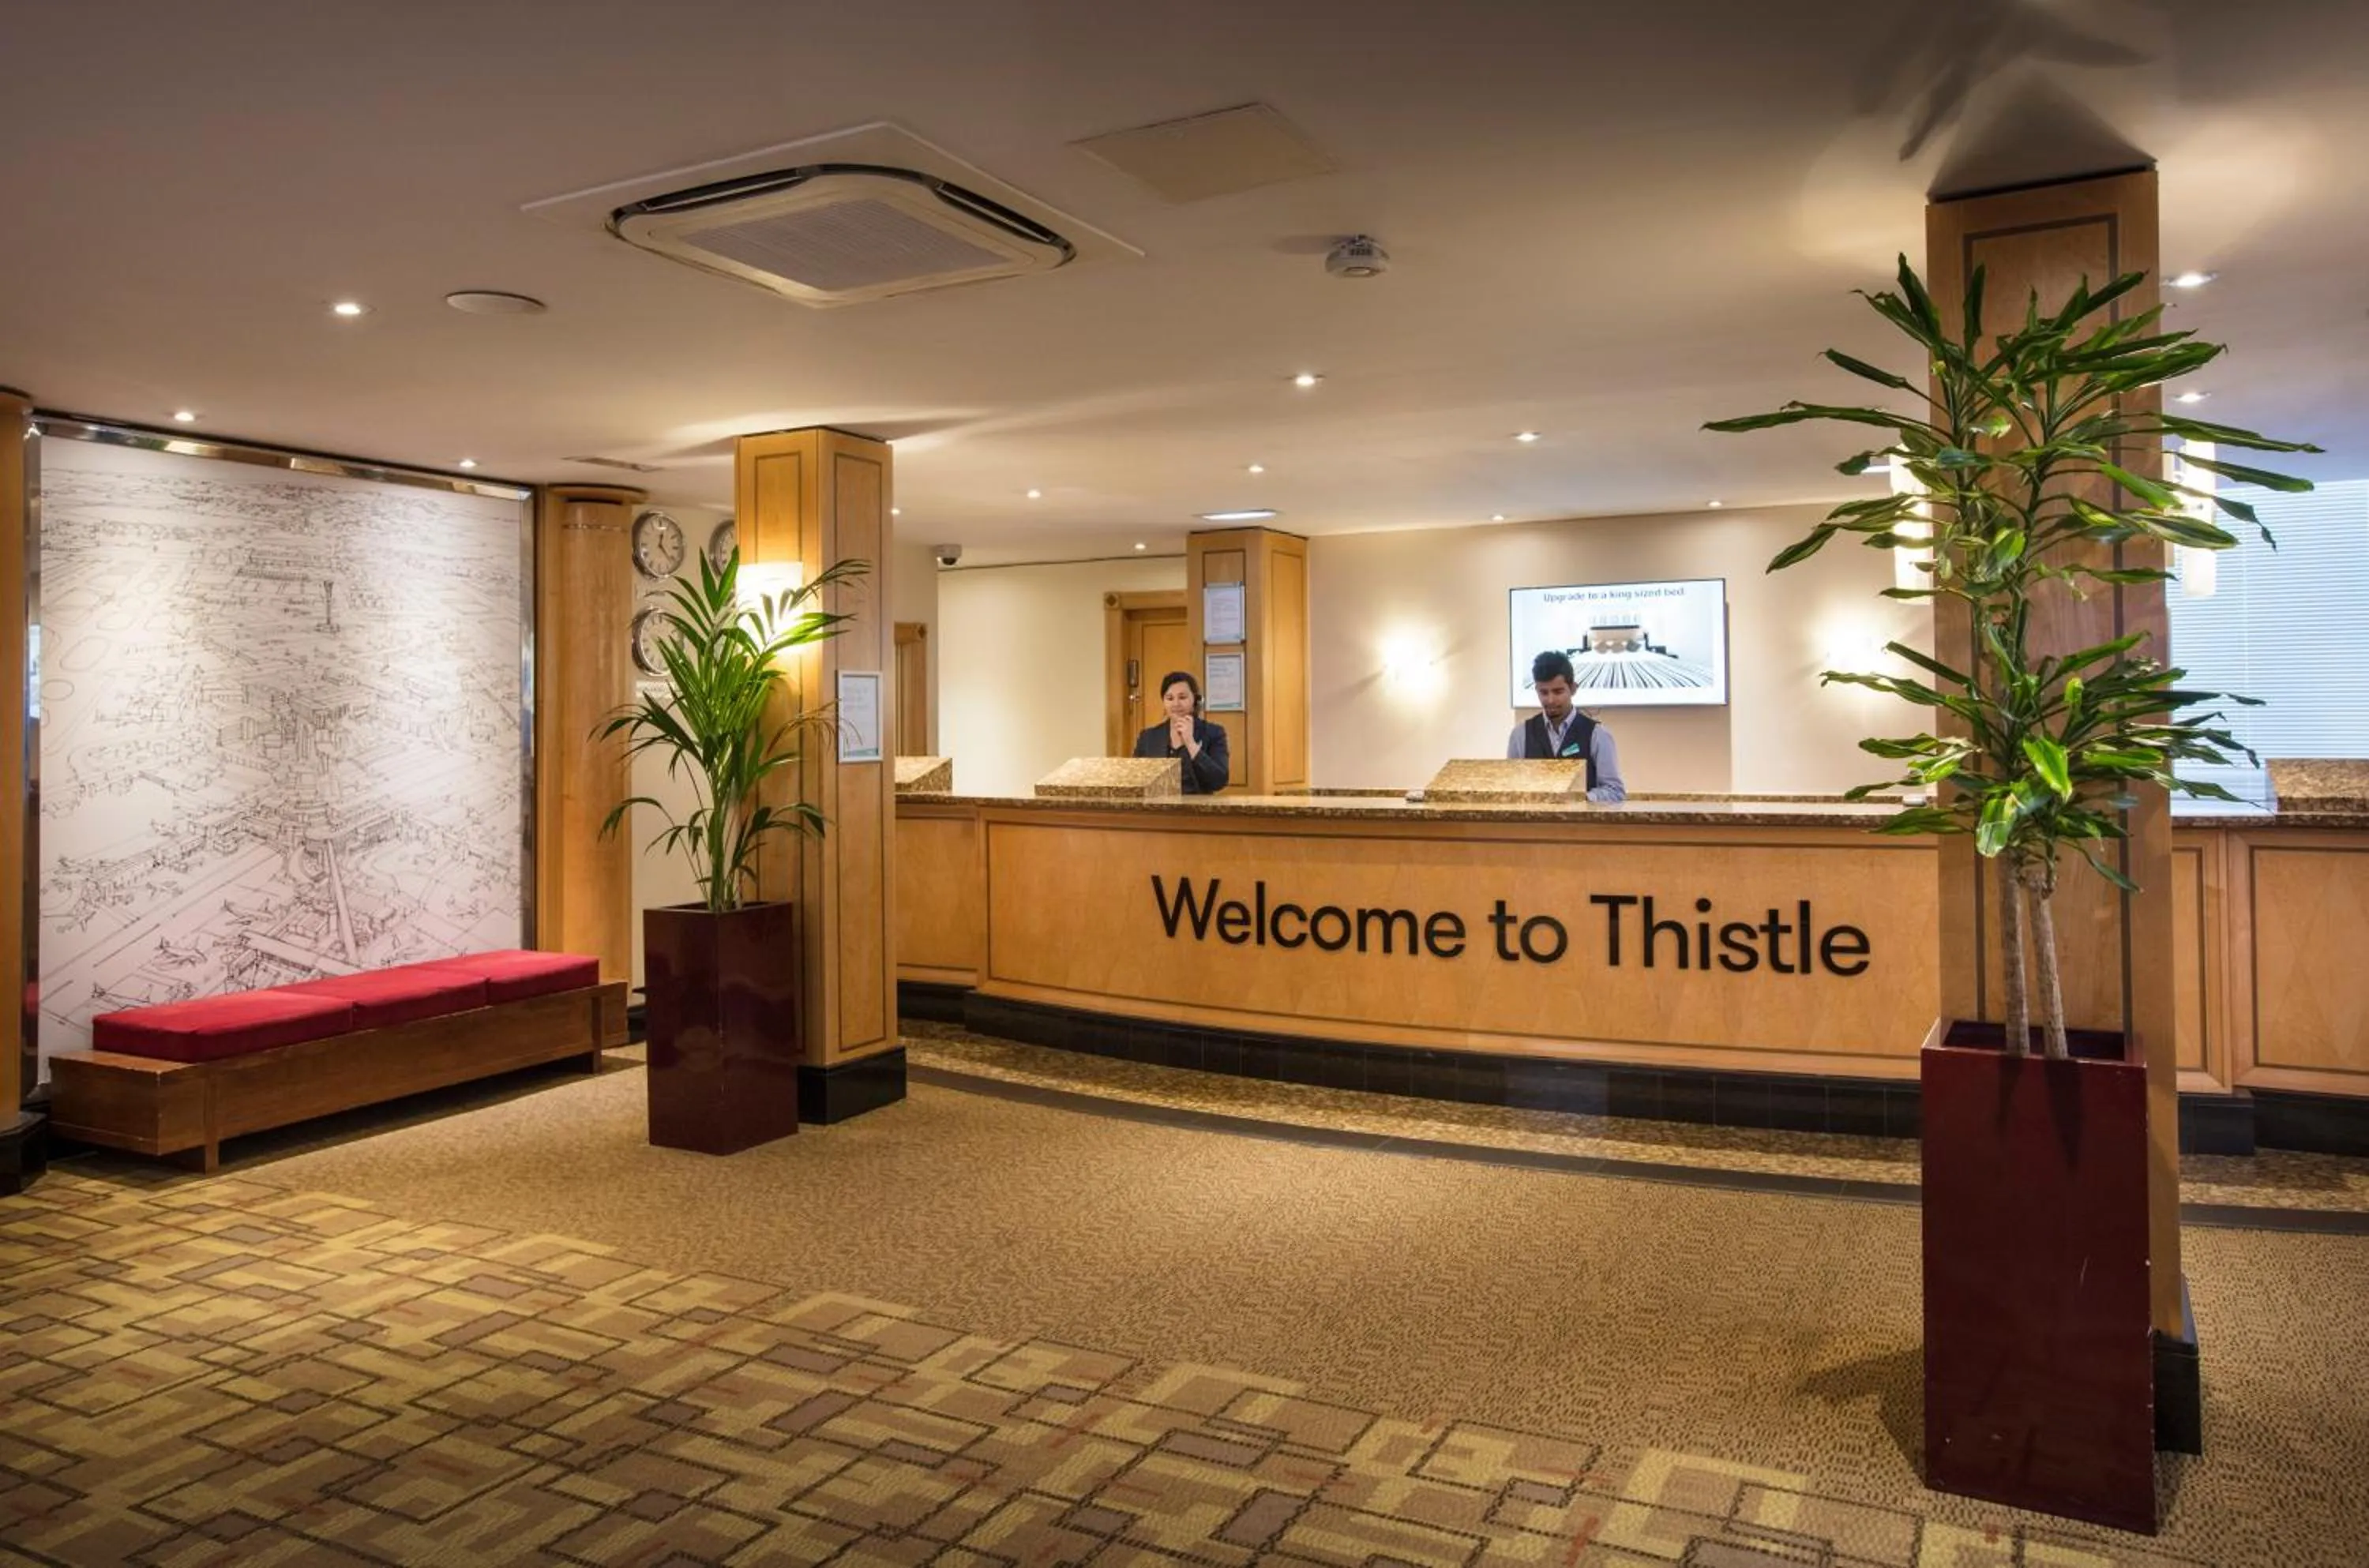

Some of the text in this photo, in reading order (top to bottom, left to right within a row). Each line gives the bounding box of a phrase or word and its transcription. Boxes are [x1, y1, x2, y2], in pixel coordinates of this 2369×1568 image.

[1543, 593, 1585, 603] Upgrade
[1609, 590, 1632, 601] king
[1634, 588, 1662, 598] sized
[1664, 587, 1684, 597] bed
[1151, 875, 1871, 977] Welcome to Thistle
